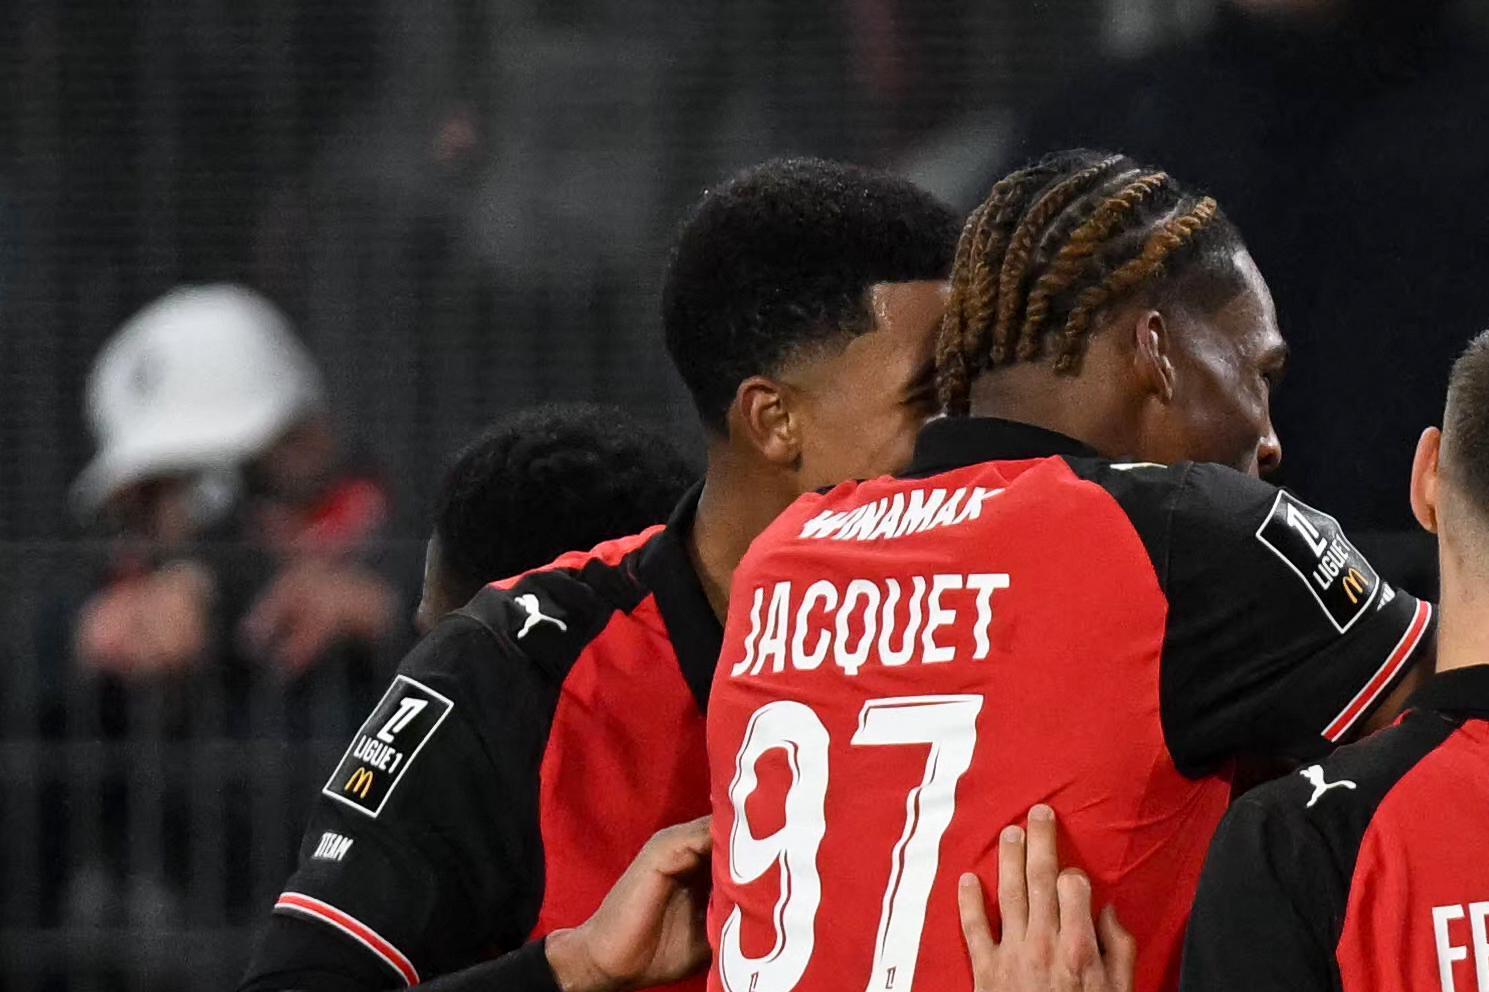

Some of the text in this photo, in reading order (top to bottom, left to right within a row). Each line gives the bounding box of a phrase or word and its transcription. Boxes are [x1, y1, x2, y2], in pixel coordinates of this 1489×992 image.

[799, 486, 1006, 541] WINAMAX
[730, 572, 1011, 677] JACQUET
[353, 734, 396, 772] LIGUE
